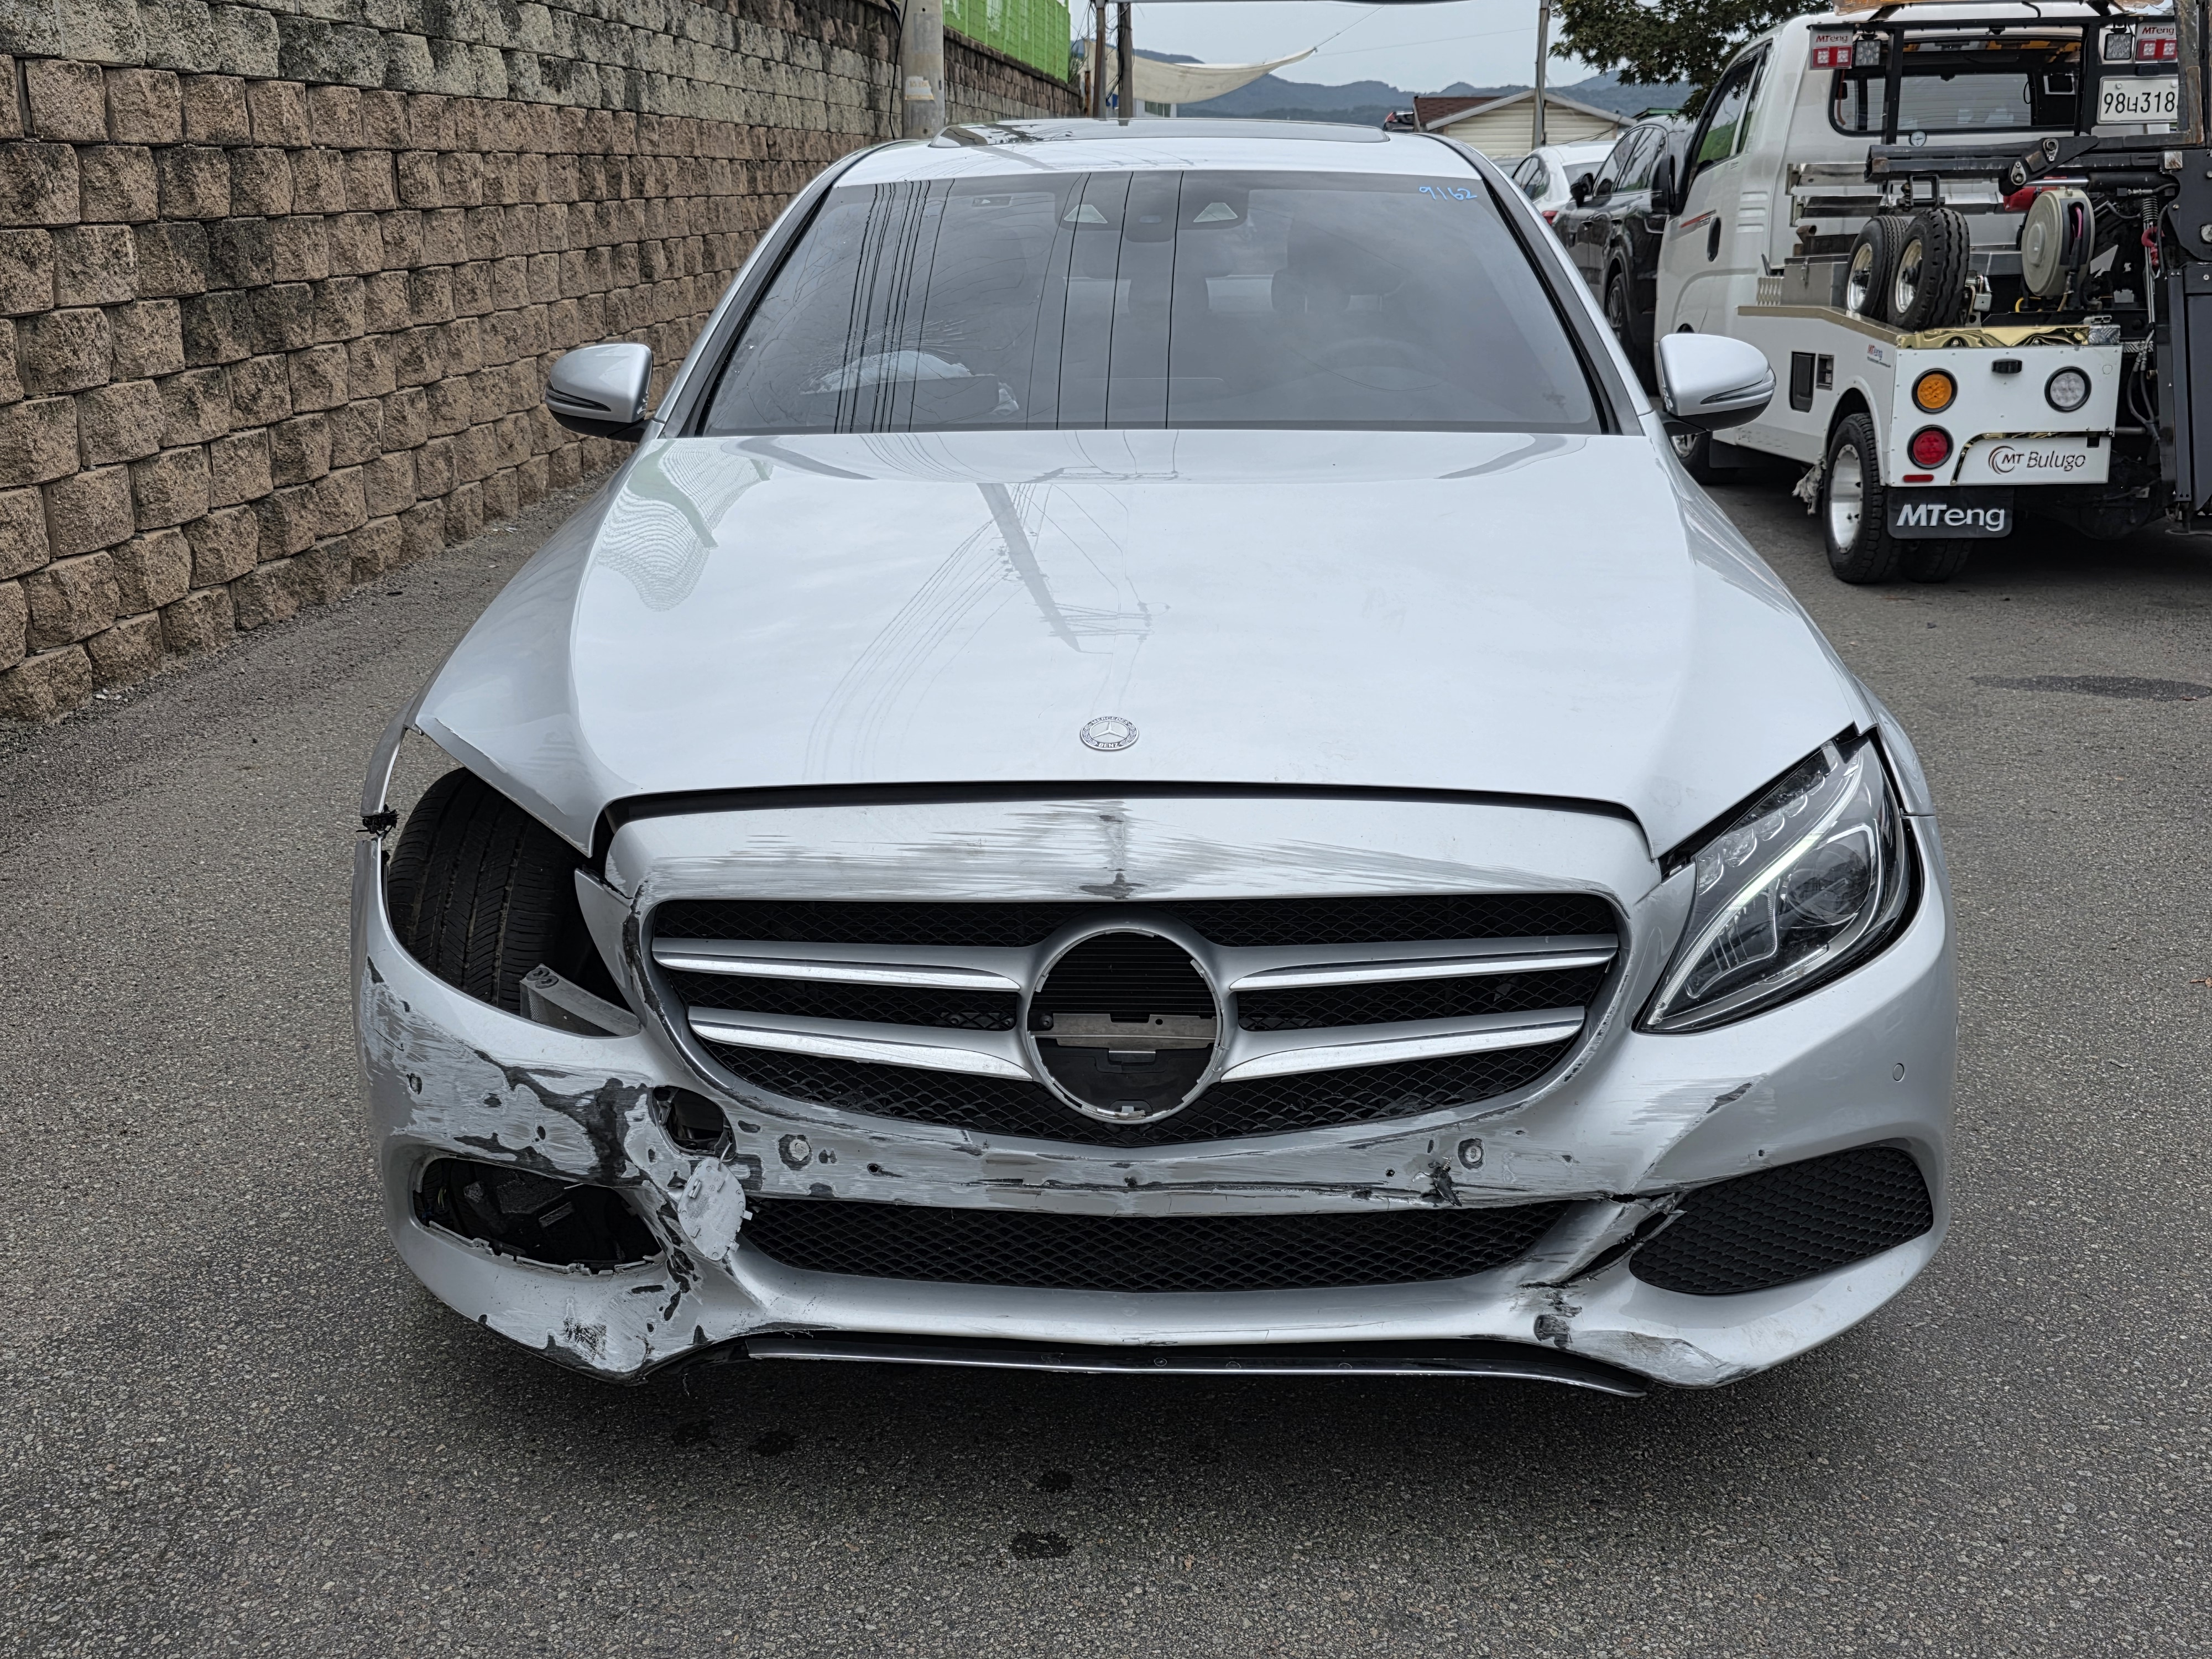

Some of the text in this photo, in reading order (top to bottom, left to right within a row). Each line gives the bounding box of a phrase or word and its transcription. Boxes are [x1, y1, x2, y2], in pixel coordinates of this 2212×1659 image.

[2142, 27, 2174, 35] MTeng
[1815, 35, 1848, 43] MTeng
[2104, 91, 2178, 114] 98너318
[1418, 186, 1478, 201] 9162
[2001, 450, 2086, 472] MT Bulugo
[1896, 503, 2005, 531] MTeng
[1091, 716, 1129, 725] MERCEDES
